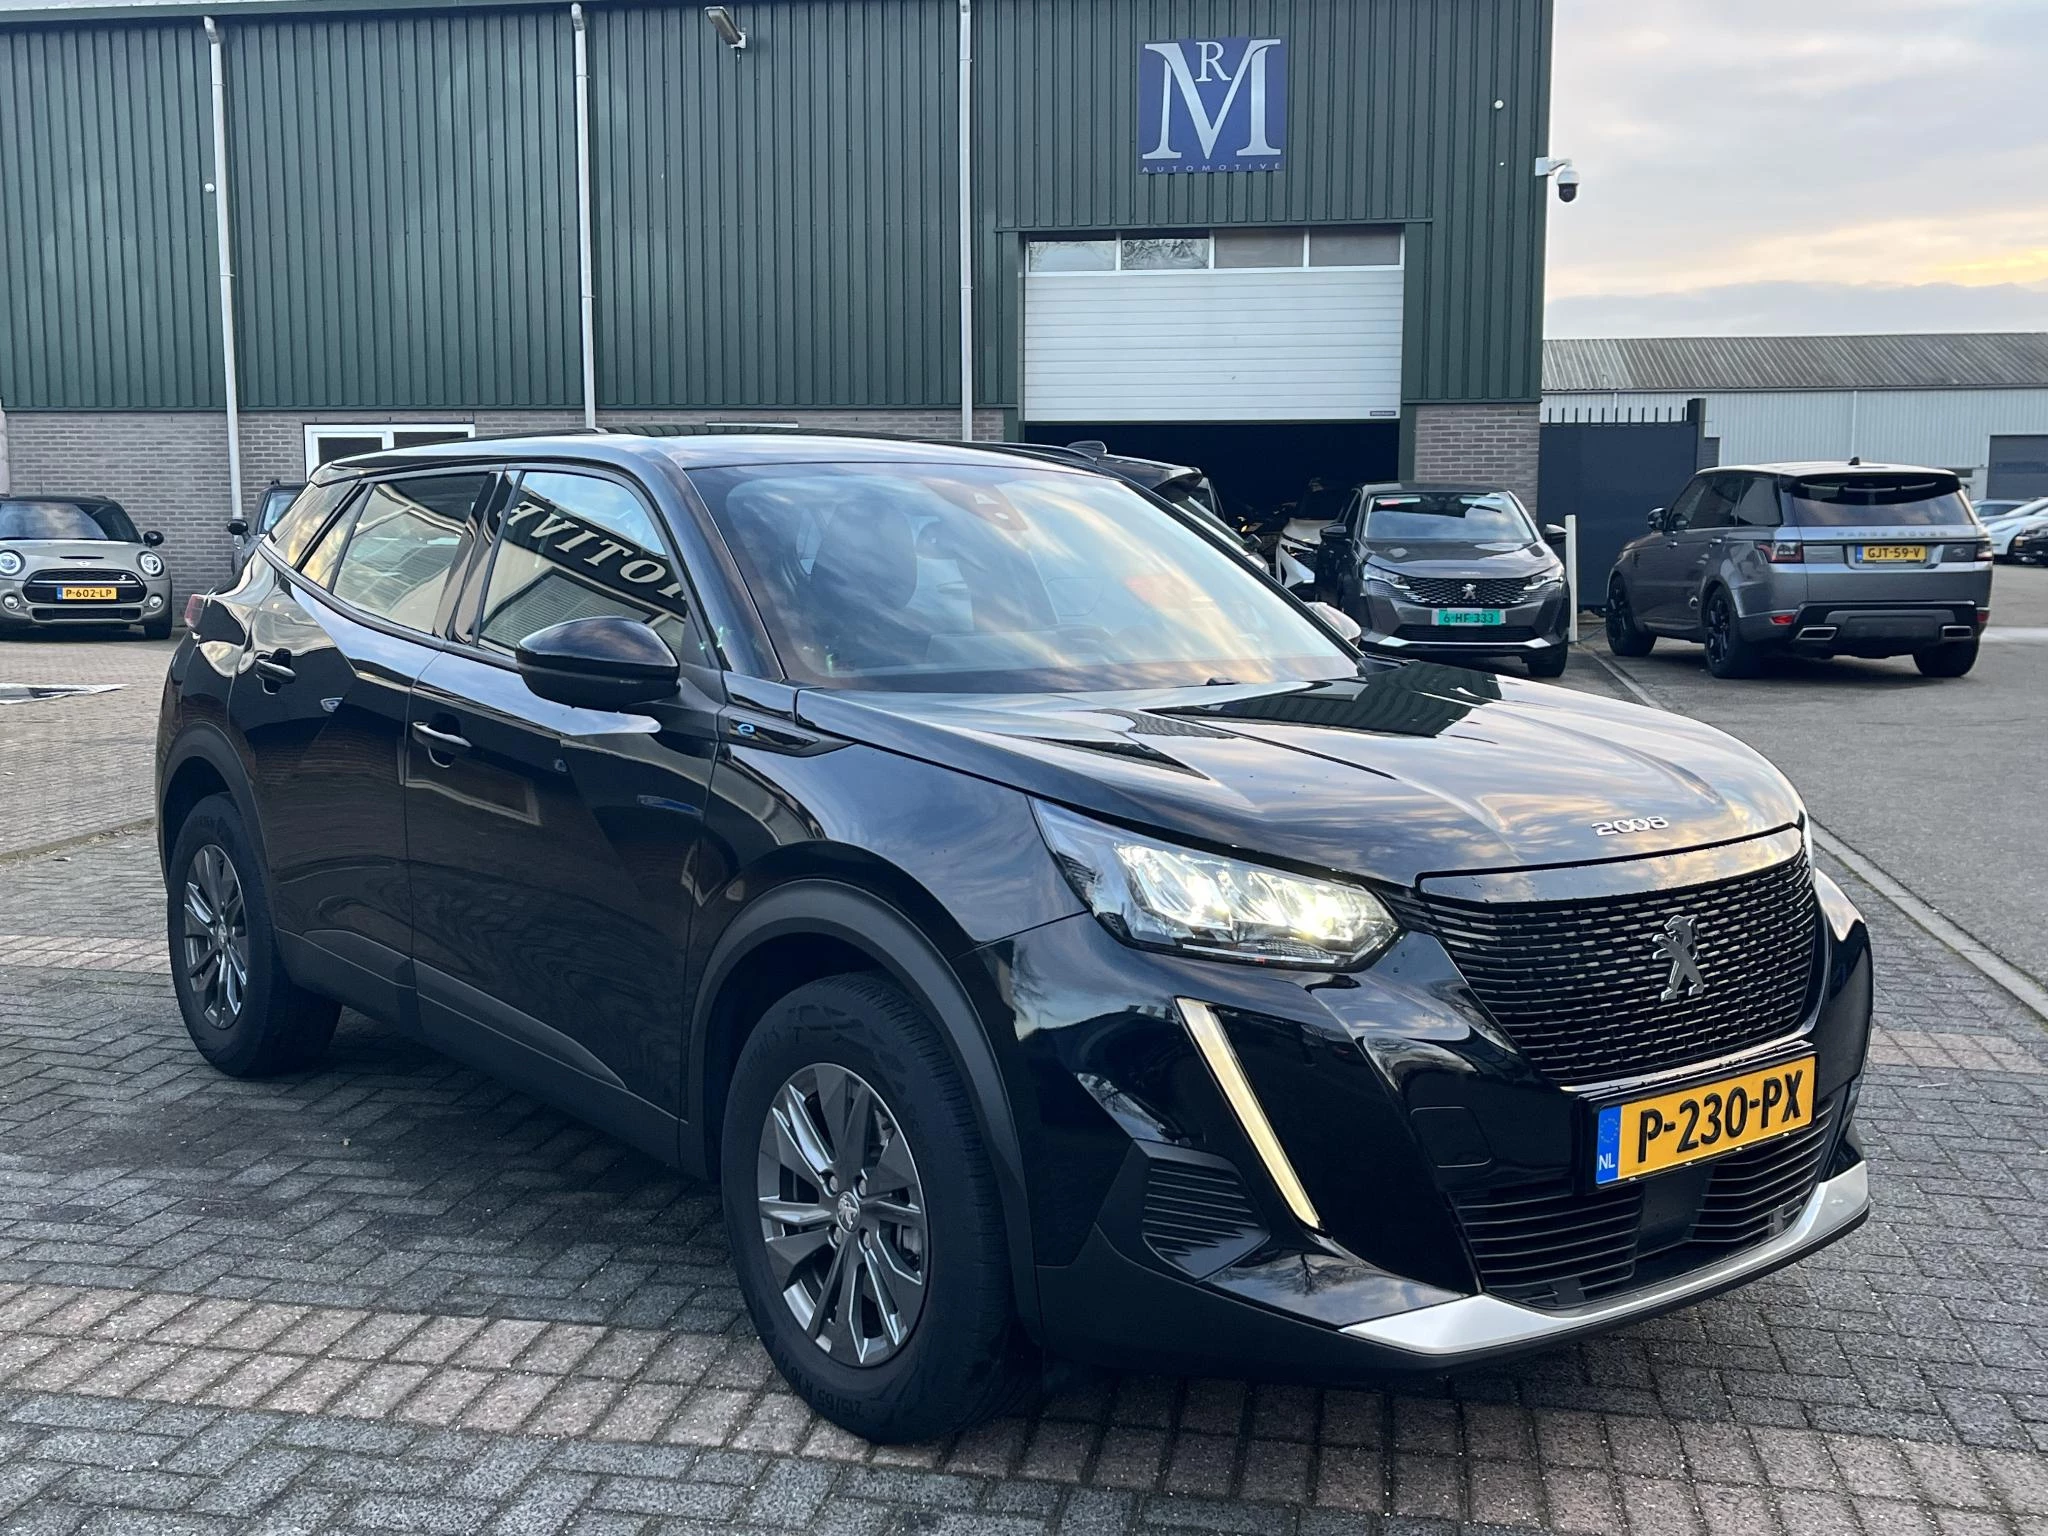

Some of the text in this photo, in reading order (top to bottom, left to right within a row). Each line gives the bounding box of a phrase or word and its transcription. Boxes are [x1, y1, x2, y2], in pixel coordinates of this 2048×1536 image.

[1142, 163, 1280, 173] AUTOMOTIVE
[1867, 547, 1921, 558] GJT-59-V
[65, 589, 112, 598] P-602-LP
[1591, 815, 1669, 837] 2008
[1598, 1070, 1803, 1170] NL P-230-PX
